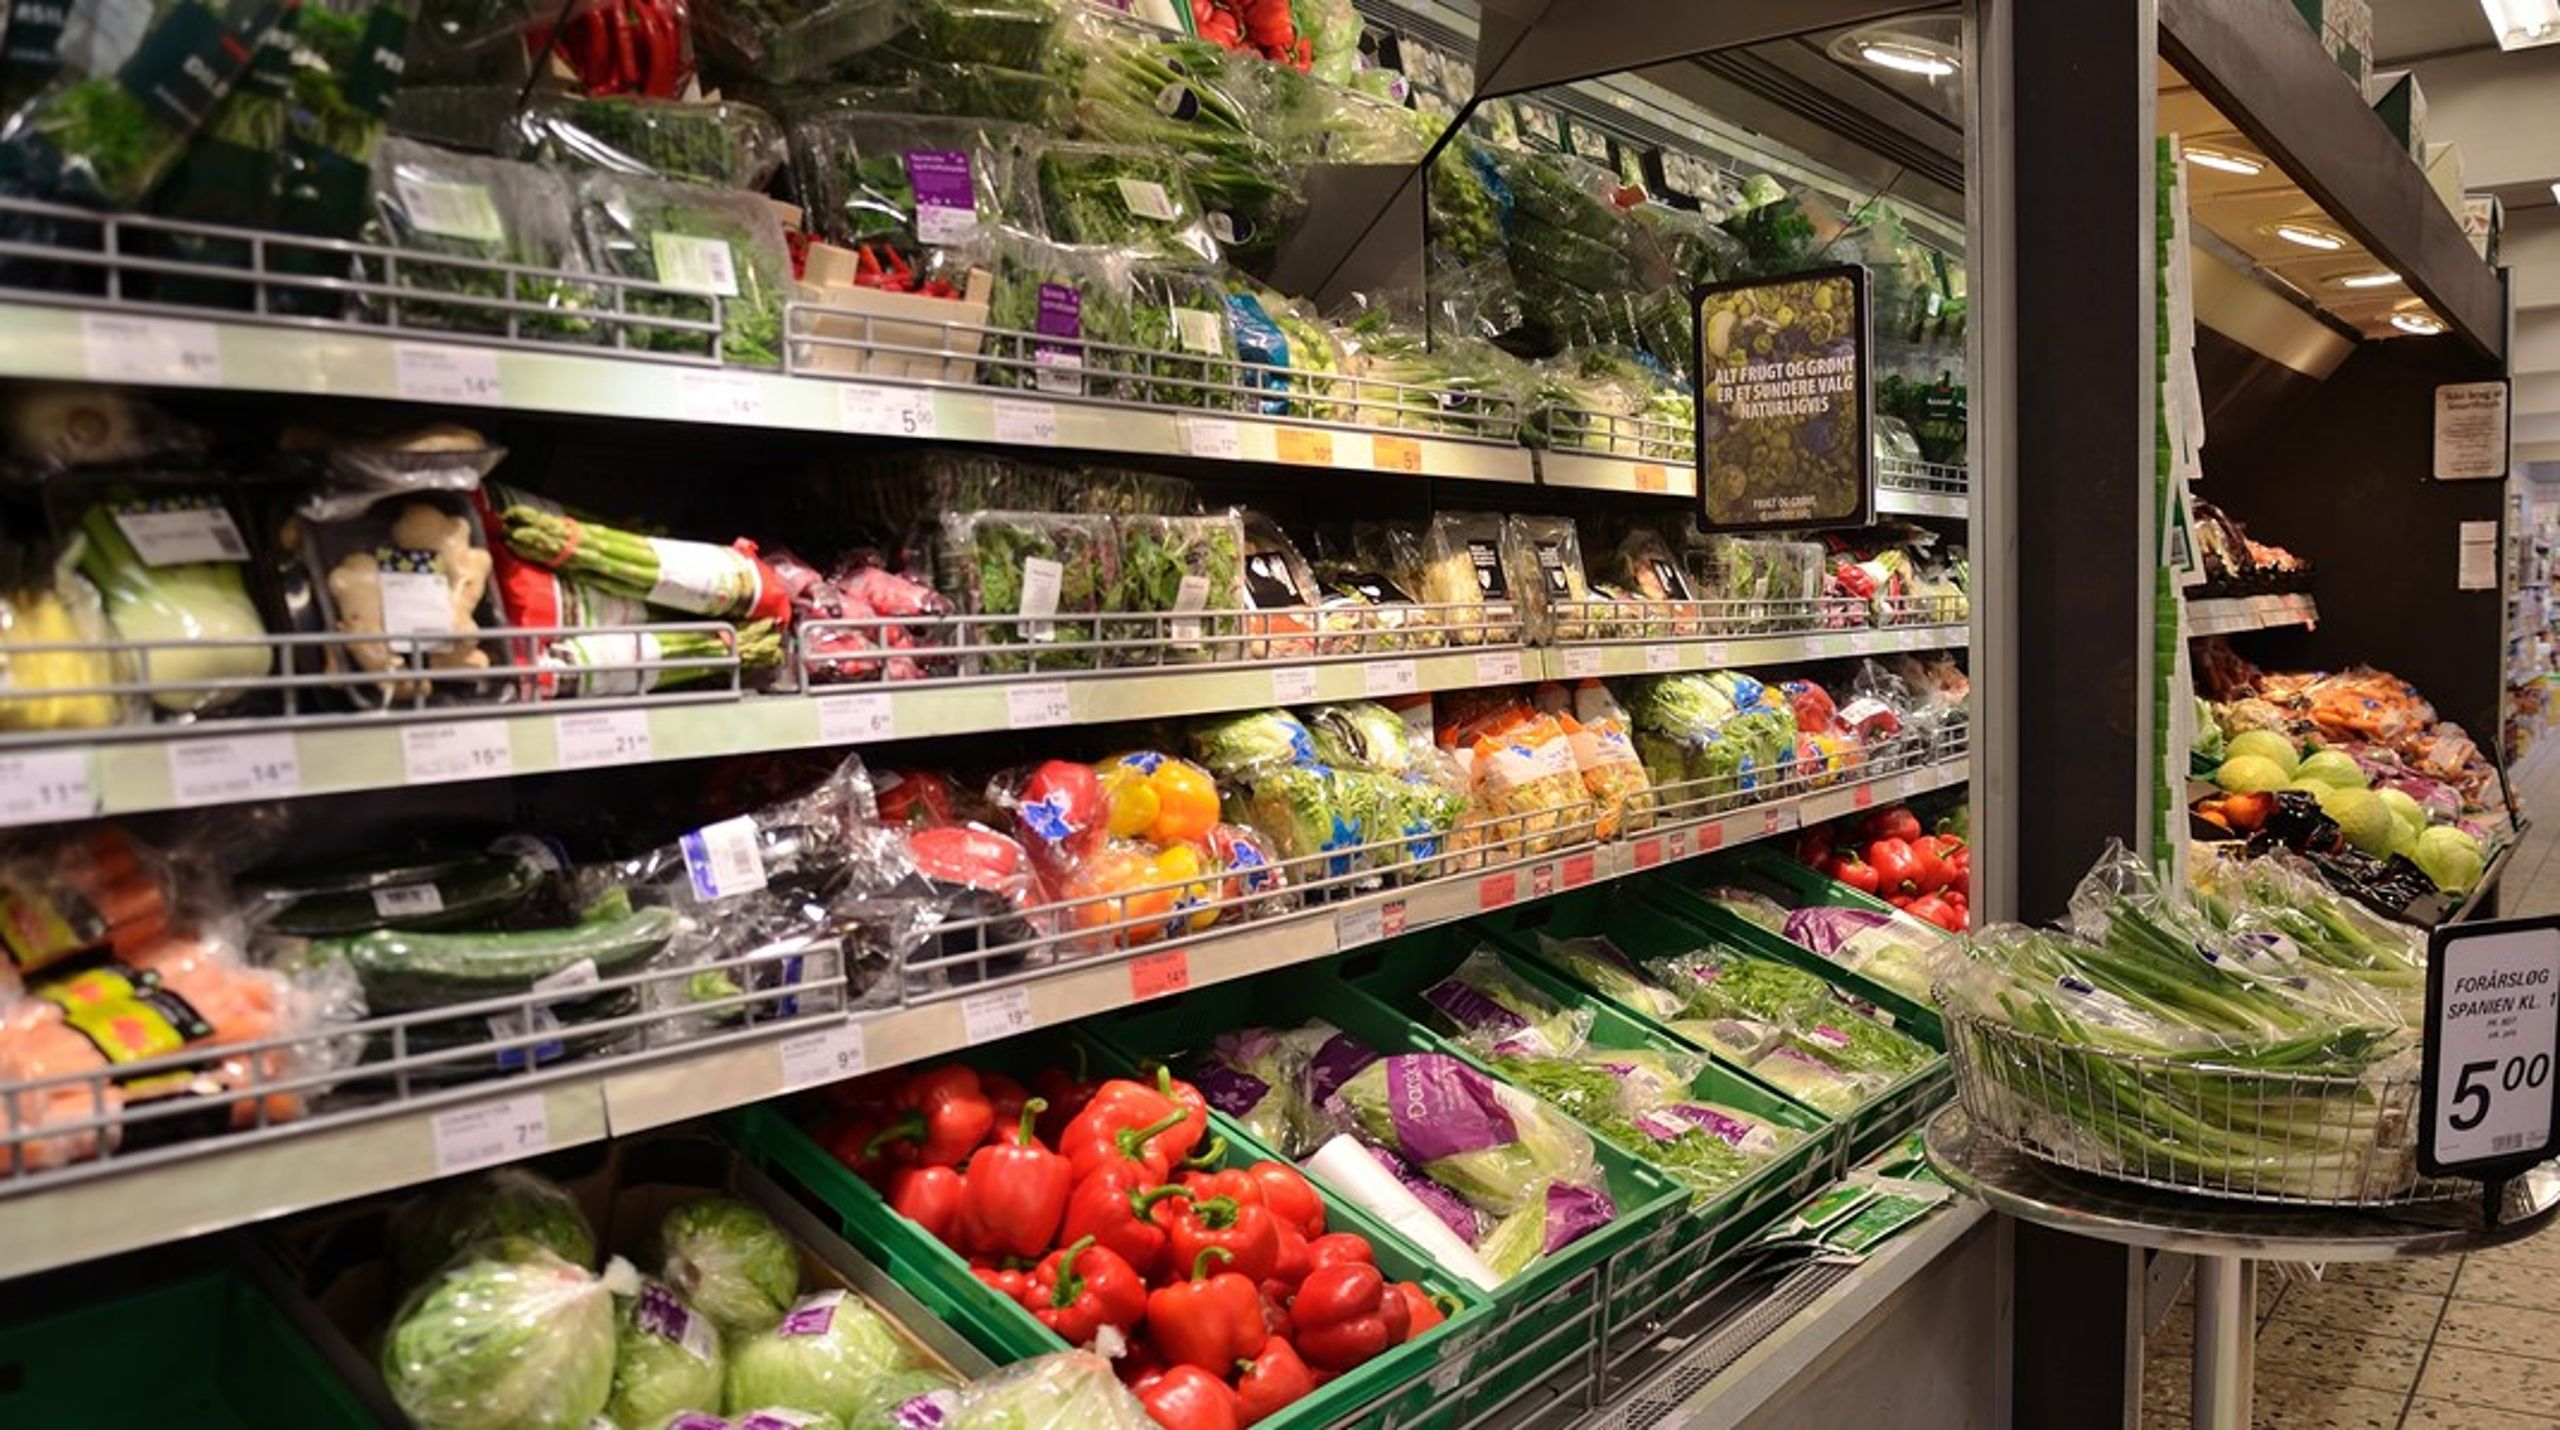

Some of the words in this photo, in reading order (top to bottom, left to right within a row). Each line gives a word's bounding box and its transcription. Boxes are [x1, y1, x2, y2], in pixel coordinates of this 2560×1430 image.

[1714, 367, 1738, 385] ALT
[1739, 362, 1784, 383] FRUGT
[1785, 360, 1805, 378] OG
[1806, 355, 1856, 375] GRØNT
[1717, 386, 1734, 403] ER
[1736, 384, 1753, 401] ET
[1753, 378, 1816, 400] SUNDERE
[1818, 375, 1853, 394] VALG
[1740, 396, 1830, 419] NATURLIGVIS
[2455, 969, 2550, 993] FORÅRSLØG
[2447, 997, 2515, 1019] SPANIEN
